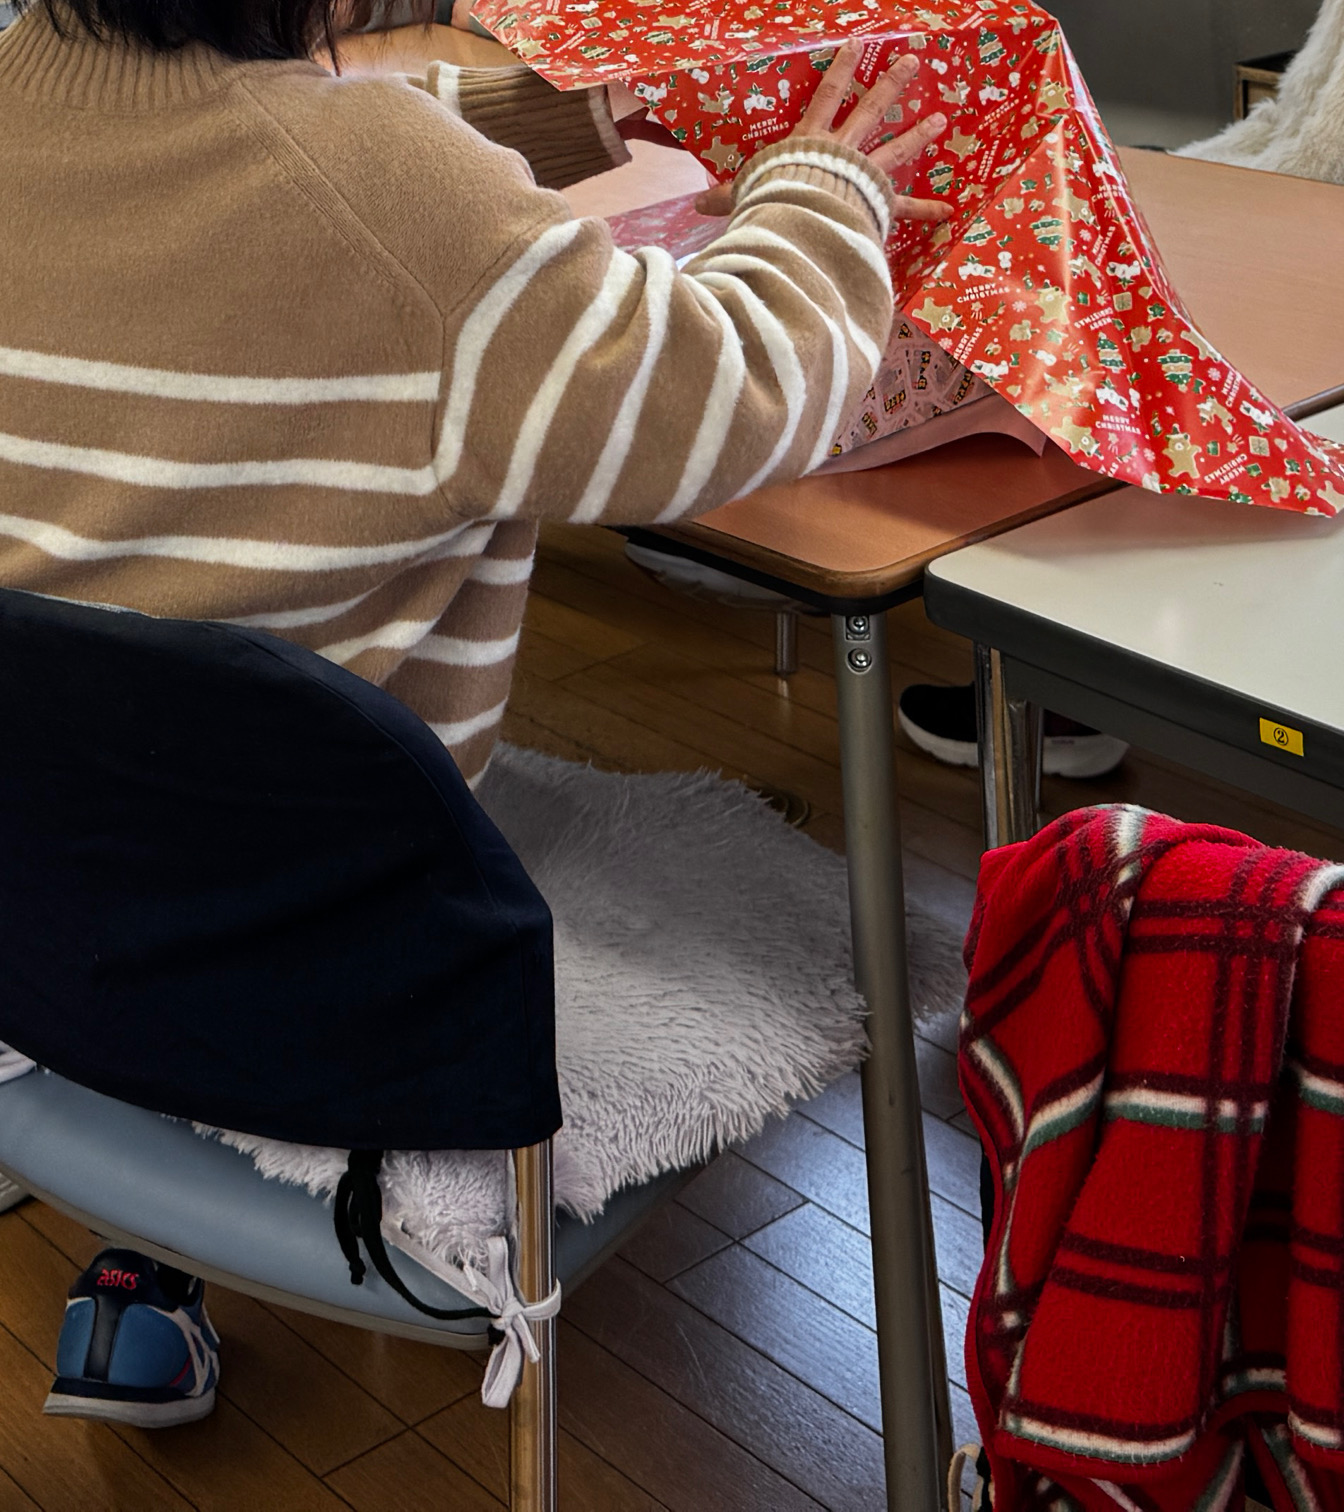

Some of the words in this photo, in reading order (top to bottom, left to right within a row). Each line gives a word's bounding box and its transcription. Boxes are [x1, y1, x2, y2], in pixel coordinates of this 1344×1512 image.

[742, 120, 790, 142] CHRISTMAS
[749, 117, 778, 132] MERRY
[957, 286, 1011, 304] CHRISTMAS
[965, 282, 997, 295] MERRY
[1095, 420, 1142, 436] CHRISTMAS
[1102, 414, 1130, 425] MERRY
[1204, 453, 1248, 484] CHRISTMAS
[97, 1268, 139, 1290] asics
